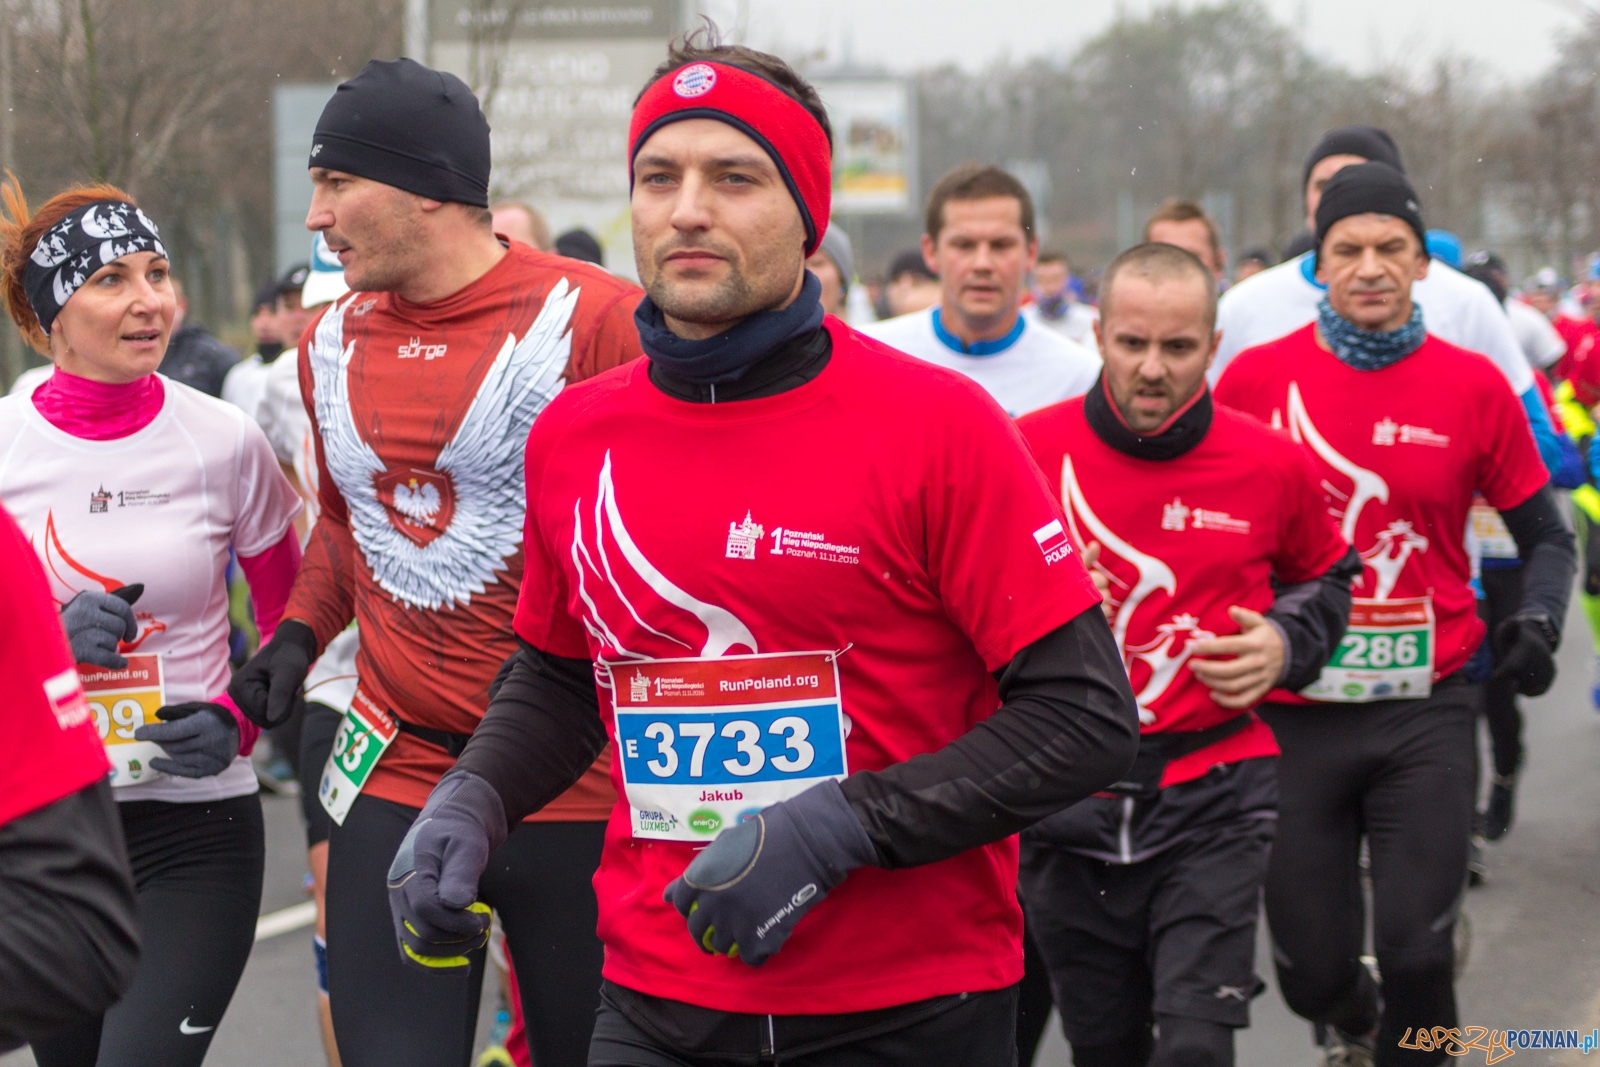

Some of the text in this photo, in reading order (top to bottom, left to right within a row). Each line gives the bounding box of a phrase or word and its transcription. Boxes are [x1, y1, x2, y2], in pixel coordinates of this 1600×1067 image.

[117, 491, 126, 507] 1
[770, 527, 783, 555] 1
[783, 529, 825, 542] Poznański
[782, 537, 860, 555] Bieg Niepodległości
[1044, 543, 1073, 567] POLSKA
[786, 547, 859, 565] Poznań, 11.11.2016
[1340, 633, 1419, 668] 286
[654, 677, 663, 696] 1
[719, 674, 819, 692] RunPoland.org
[334, 714, 370, 773] 53
[625, 716, 816, 778] E 3733
[699, 790, 743, 802] Jakub
[640, 810, 665, 821] GRUPA
[693, 818, 720, 829] energy
[640, 821, 670, 832] LUXMED
